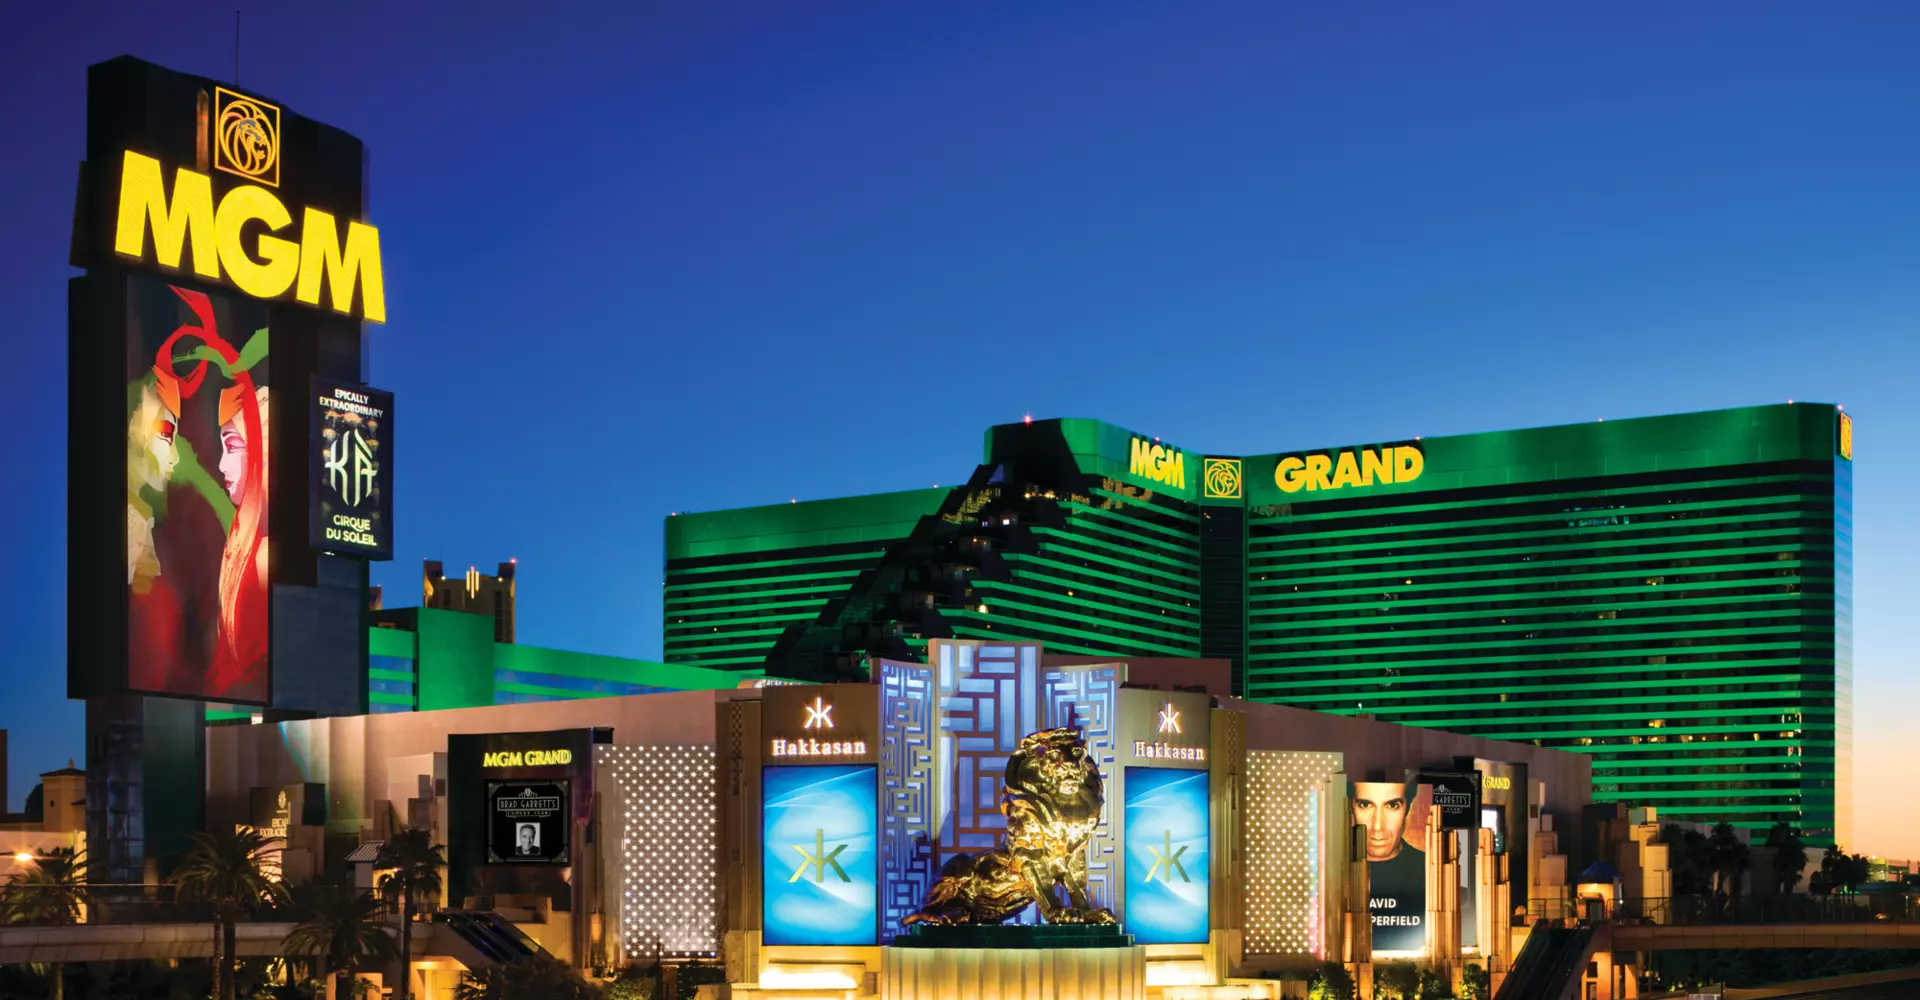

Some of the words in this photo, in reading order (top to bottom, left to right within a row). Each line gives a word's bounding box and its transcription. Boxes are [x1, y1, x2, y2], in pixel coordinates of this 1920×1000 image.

[115, 150, 387, 323] MGM
[334, 388, 369, 404] EPICALLY
[319, 396, 384, 418] EXTRAORDINARY
[1129, 436, 1186, 491] MGM
[1274, 445, 1425, 494] GRAND
[333, 514, 371, 532] CIRQUE
[326, 527, 341, 541] DU
[343, 530, 378, 547] SOLEIL
[771, 738, 867, 757] Hakkasan
[1133, 740, 1205, 761] Hakkasan
[482, 751, 523, 768] MGM
[524, 749, 573, 767] GRAND
[500, 799, 518, 809] BRAD
[1369, 898, 1397, 909] AVID
[1371, 915, 1421, 927] PERFIELD
